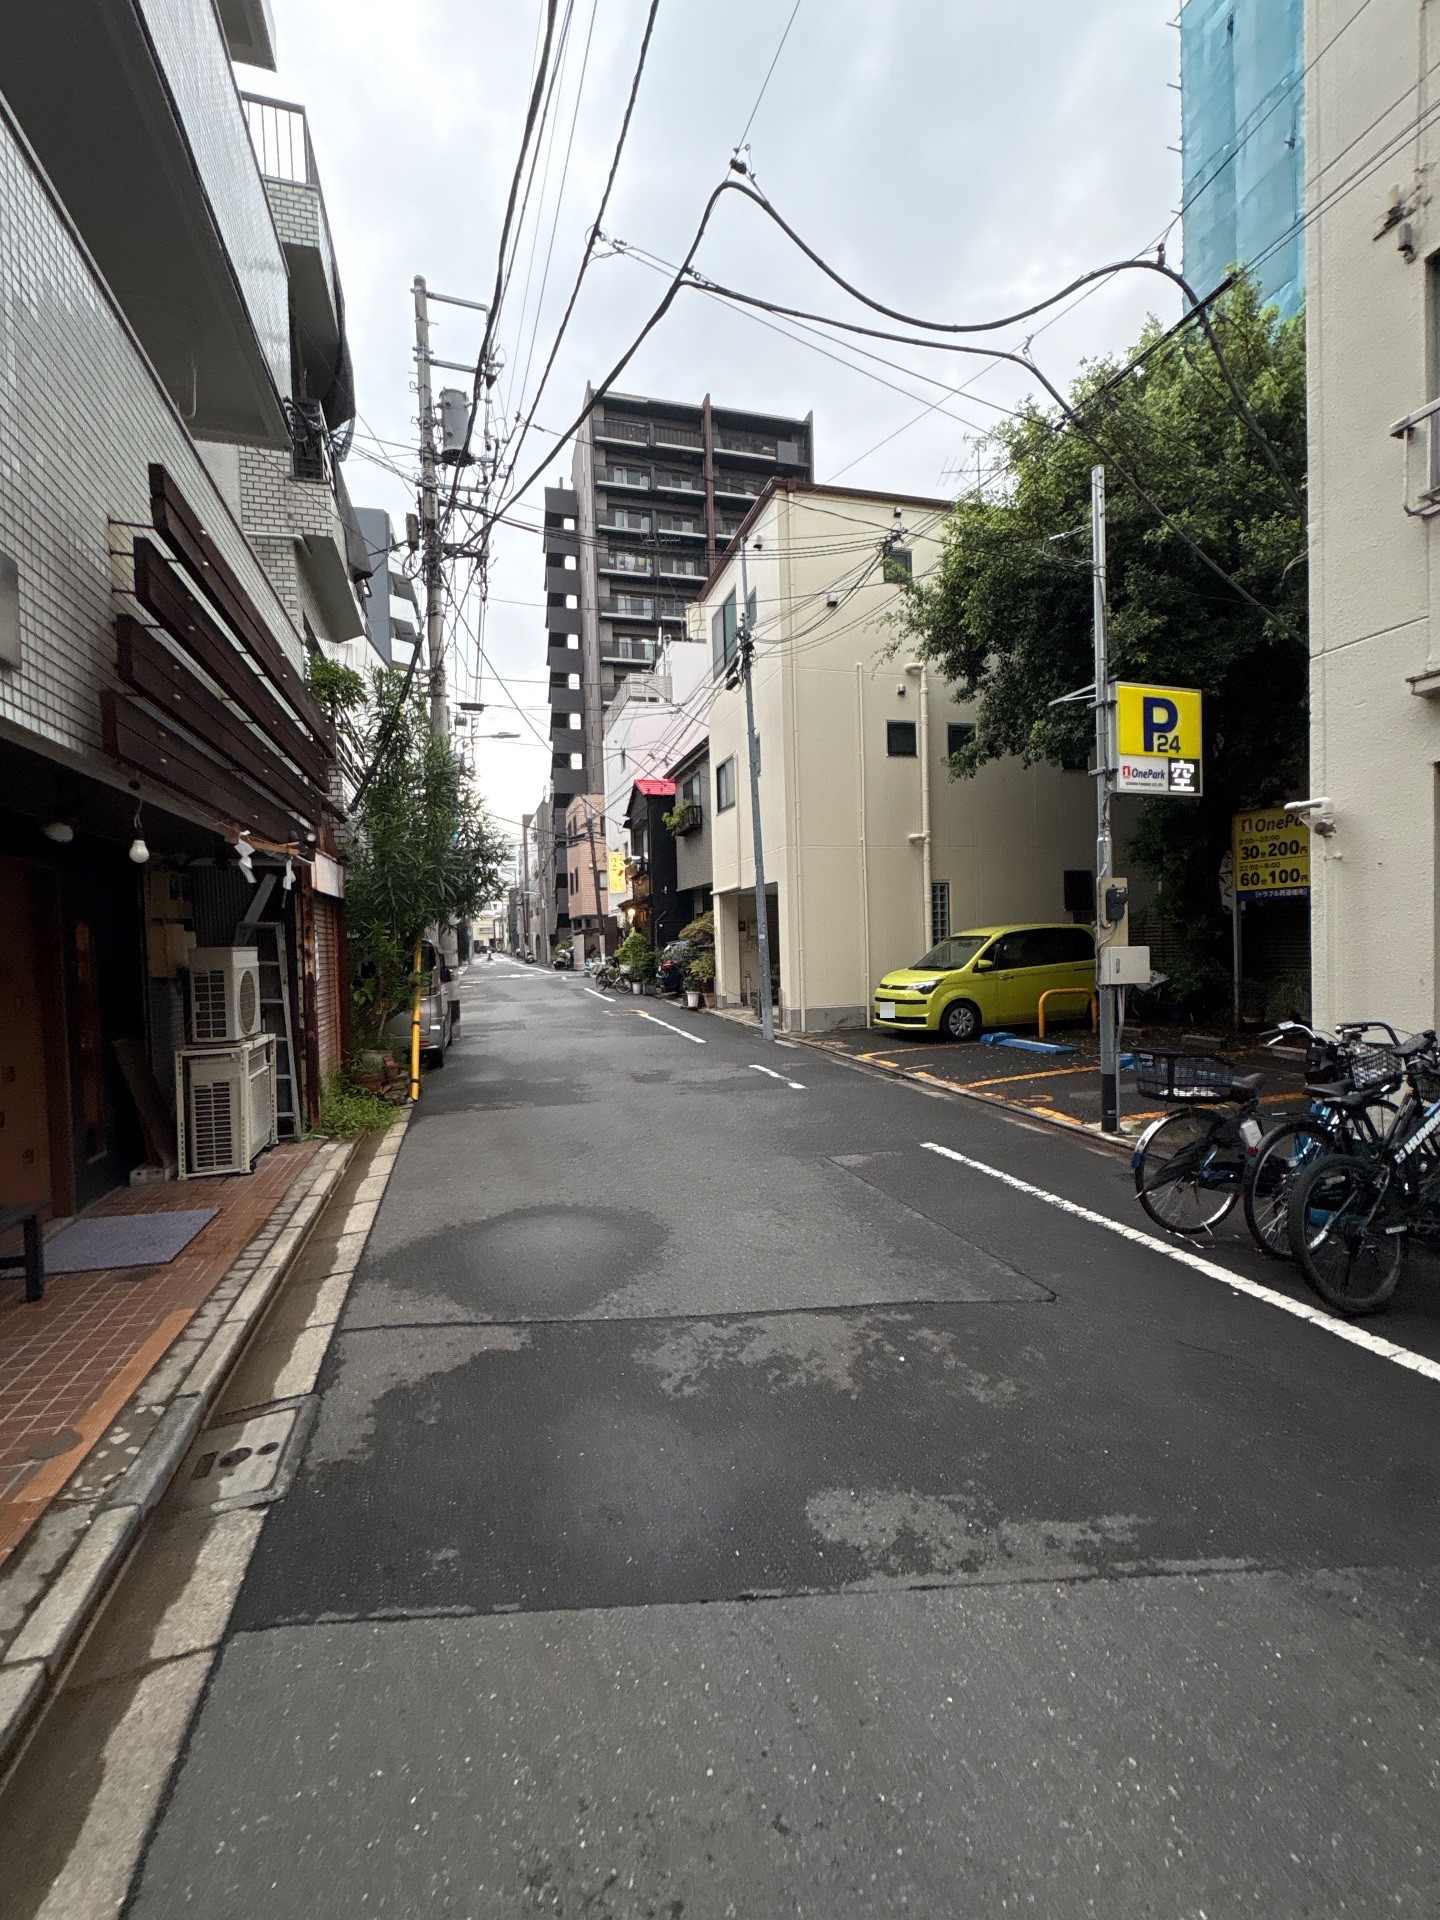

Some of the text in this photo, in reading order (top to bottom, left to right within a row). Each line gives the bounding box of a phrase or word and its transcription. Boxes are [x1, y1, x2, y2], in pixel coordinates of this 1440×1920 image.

[1143, 696, 1178, 752] P
[1157, 734, 1181, 753] 24
[1132, 768, 1166, 780] OnePark
[1170, 760, 1195, 792] 空
